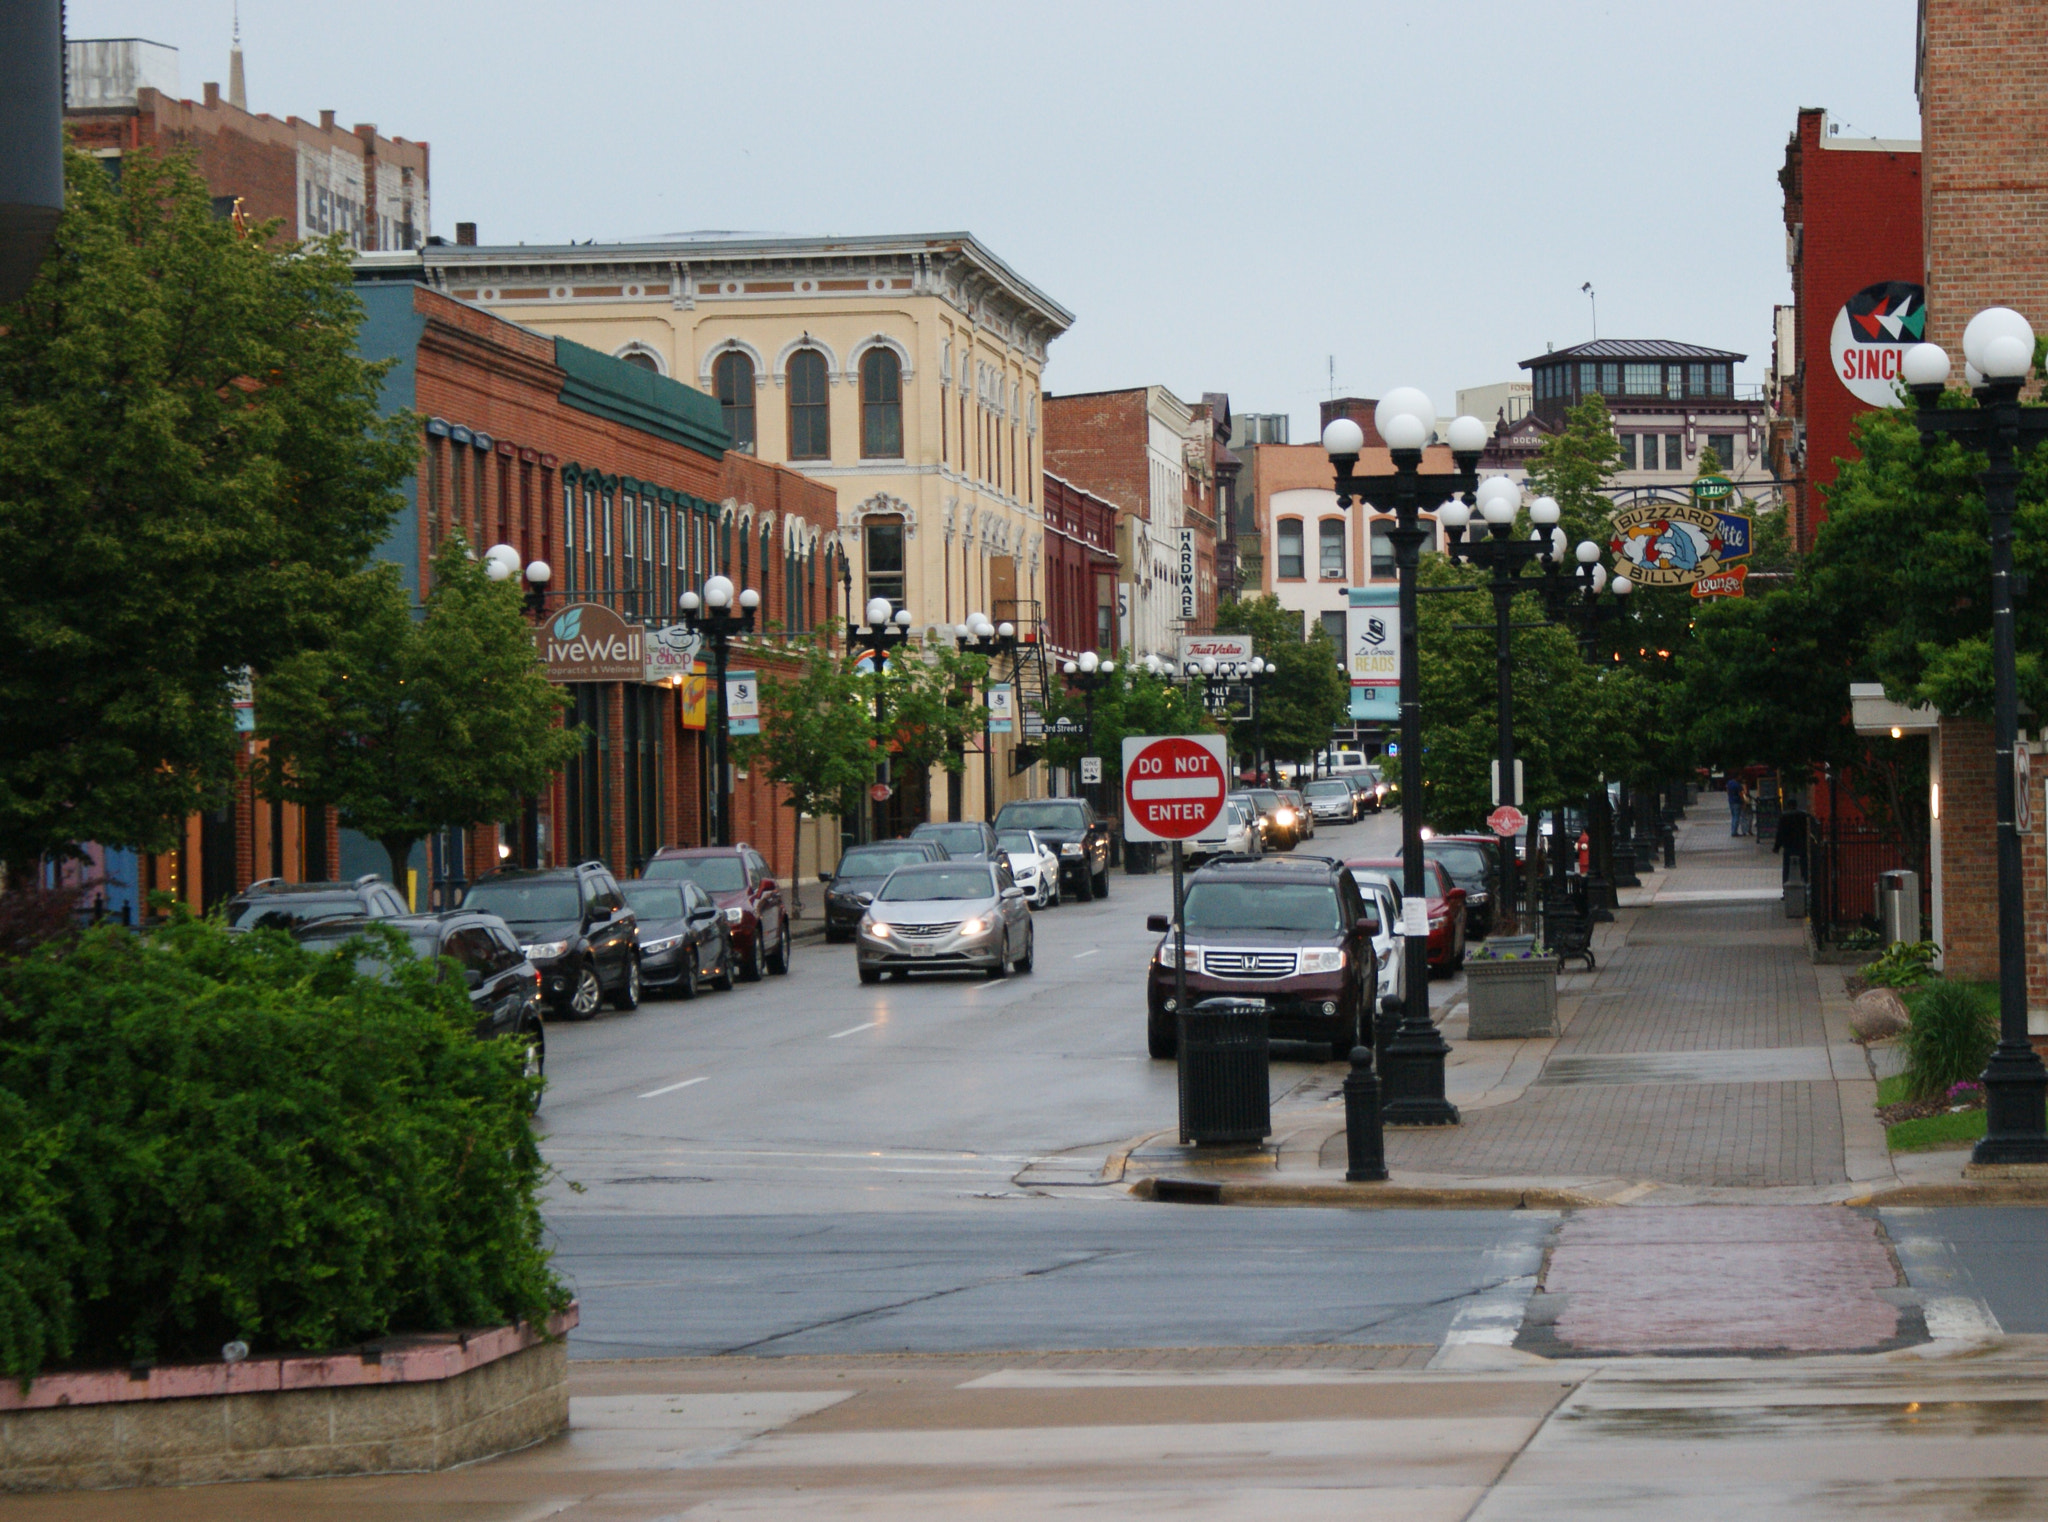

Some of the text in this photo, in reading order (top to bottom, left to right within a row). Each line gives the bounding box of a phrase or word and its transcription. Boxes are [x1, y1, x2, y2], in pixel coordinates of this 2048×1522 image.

[1618, 507, 1714, 530] BUZZARD
[1180, 531, 1193, 617] HARDWARE
[1629, 565, 1705, 585] BILLY'S
[1697, 577, 1740, 594] Lounge
[656, 646, 692, 670] Shop
[1355, 657, 1396, 673] READS
[1044, 724, 1084, 733] 3rd Street S
[1139, 756, 1210, 774] DO NOT
[1148, 804, 1205, 821] ENTER
